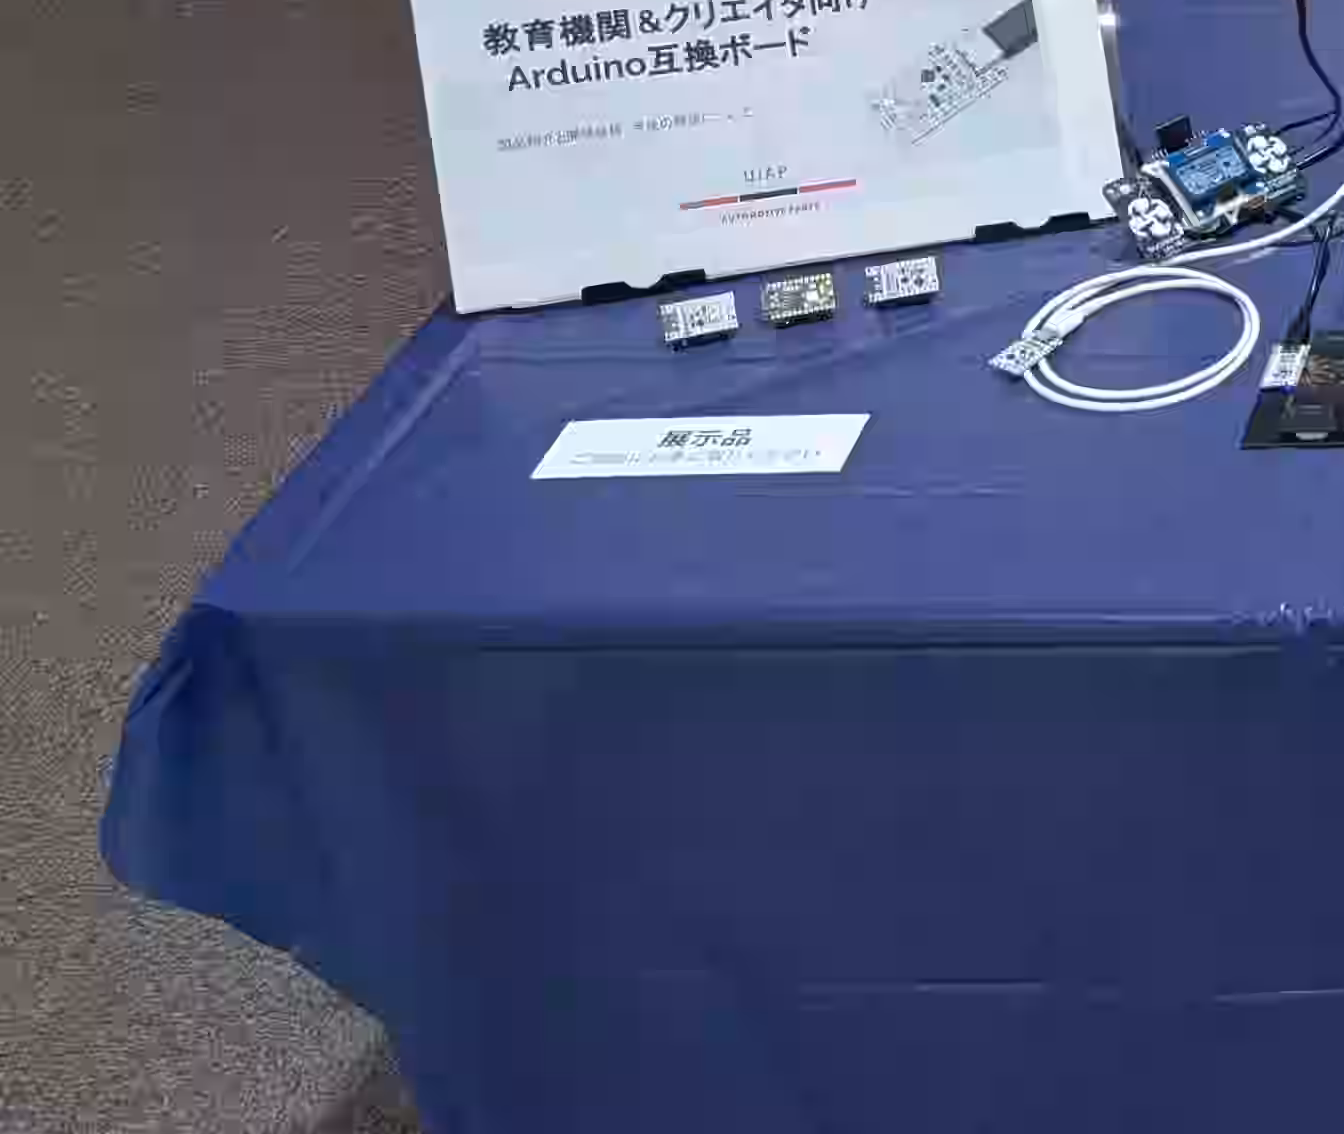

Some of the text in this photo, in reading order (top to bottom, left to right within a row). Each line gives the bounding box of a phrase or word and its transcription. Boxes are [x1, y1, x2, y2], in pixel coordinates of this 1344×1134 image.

[508, 27, 812, 92] Arduino互換ボード
[657, 428, 752, 448] 展示品
